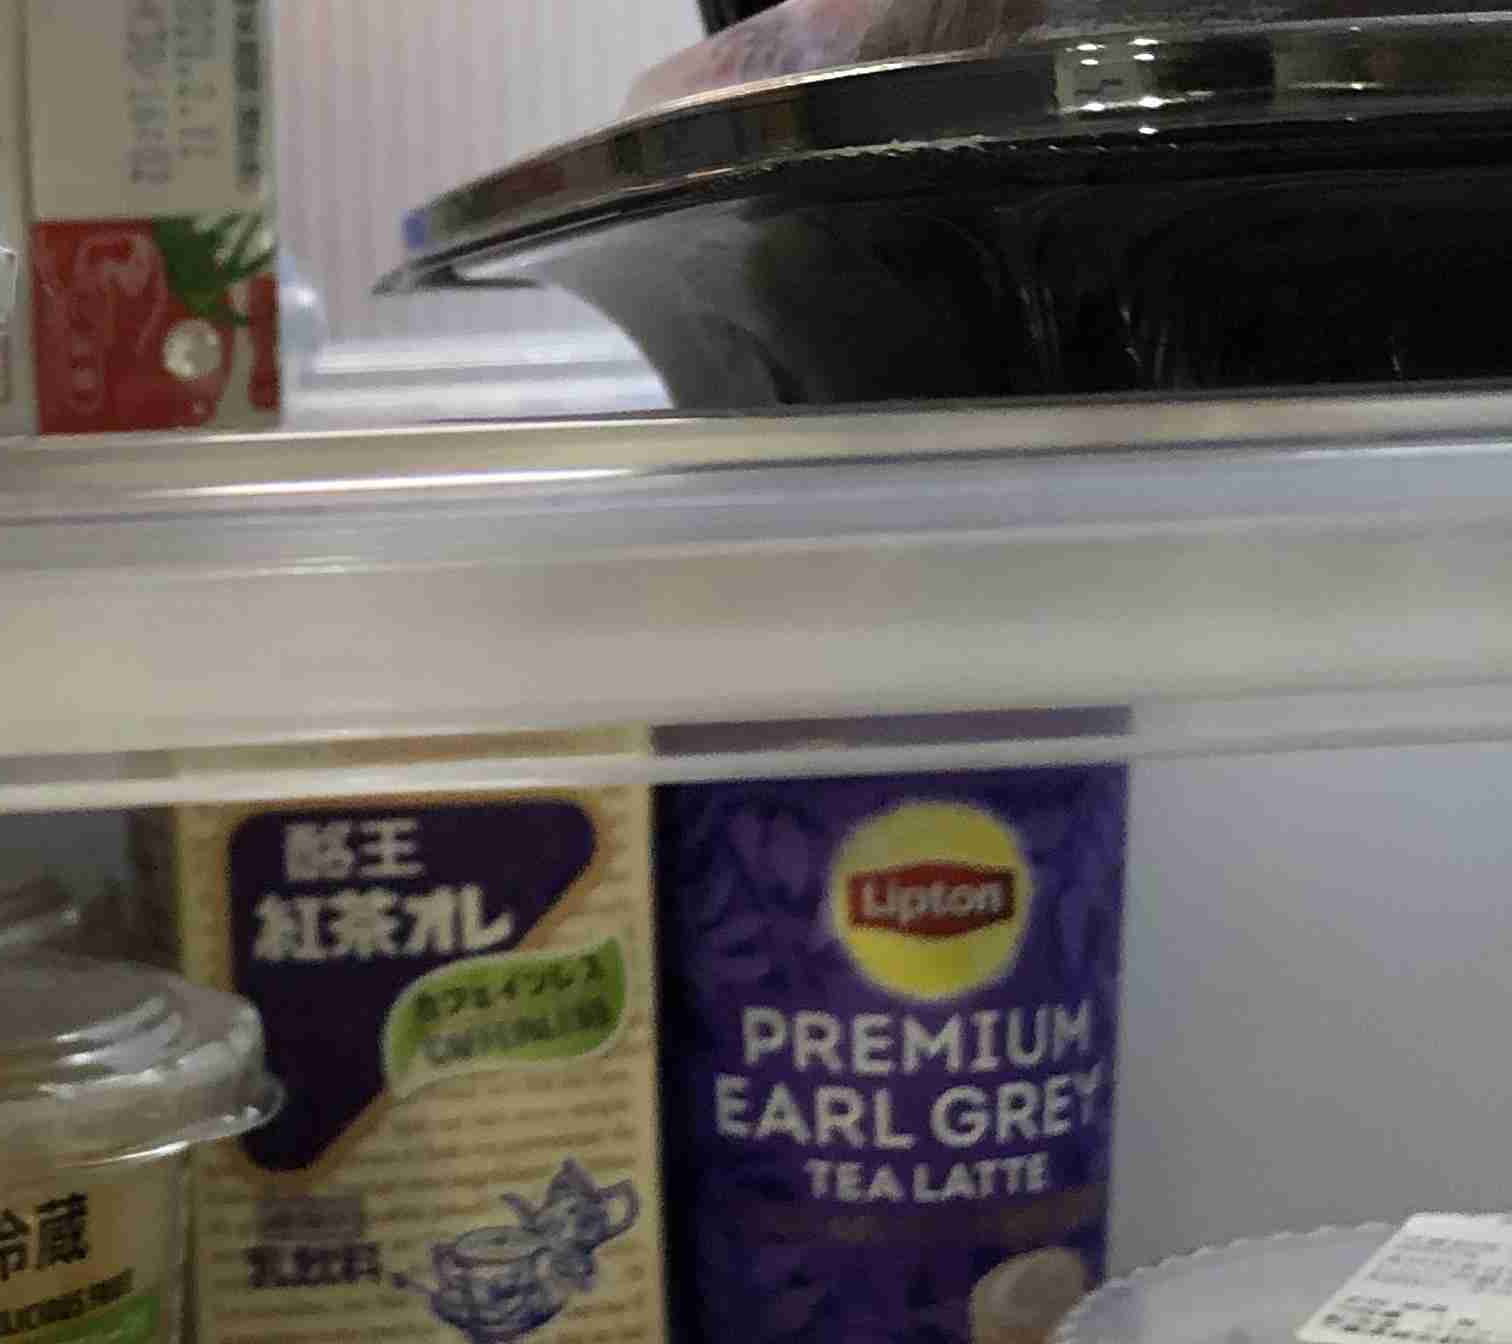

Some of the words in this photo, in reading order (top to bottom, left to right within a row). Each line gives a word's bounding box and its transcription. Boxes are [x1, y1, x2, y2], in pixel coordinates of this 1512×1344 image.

[252, 885, 514, 960] 紅茶オレ
[862, 879, 1004, 922] Lipton
[741, 1000, 1091, 1076] PREMIUM
[714, 1072, 915, 1150] EARL
[930, 1062, 1106, 1148] GREY
[805, 1157, 904, 1203] TEA
[912, 1153, 1050, 1204] LATTE
